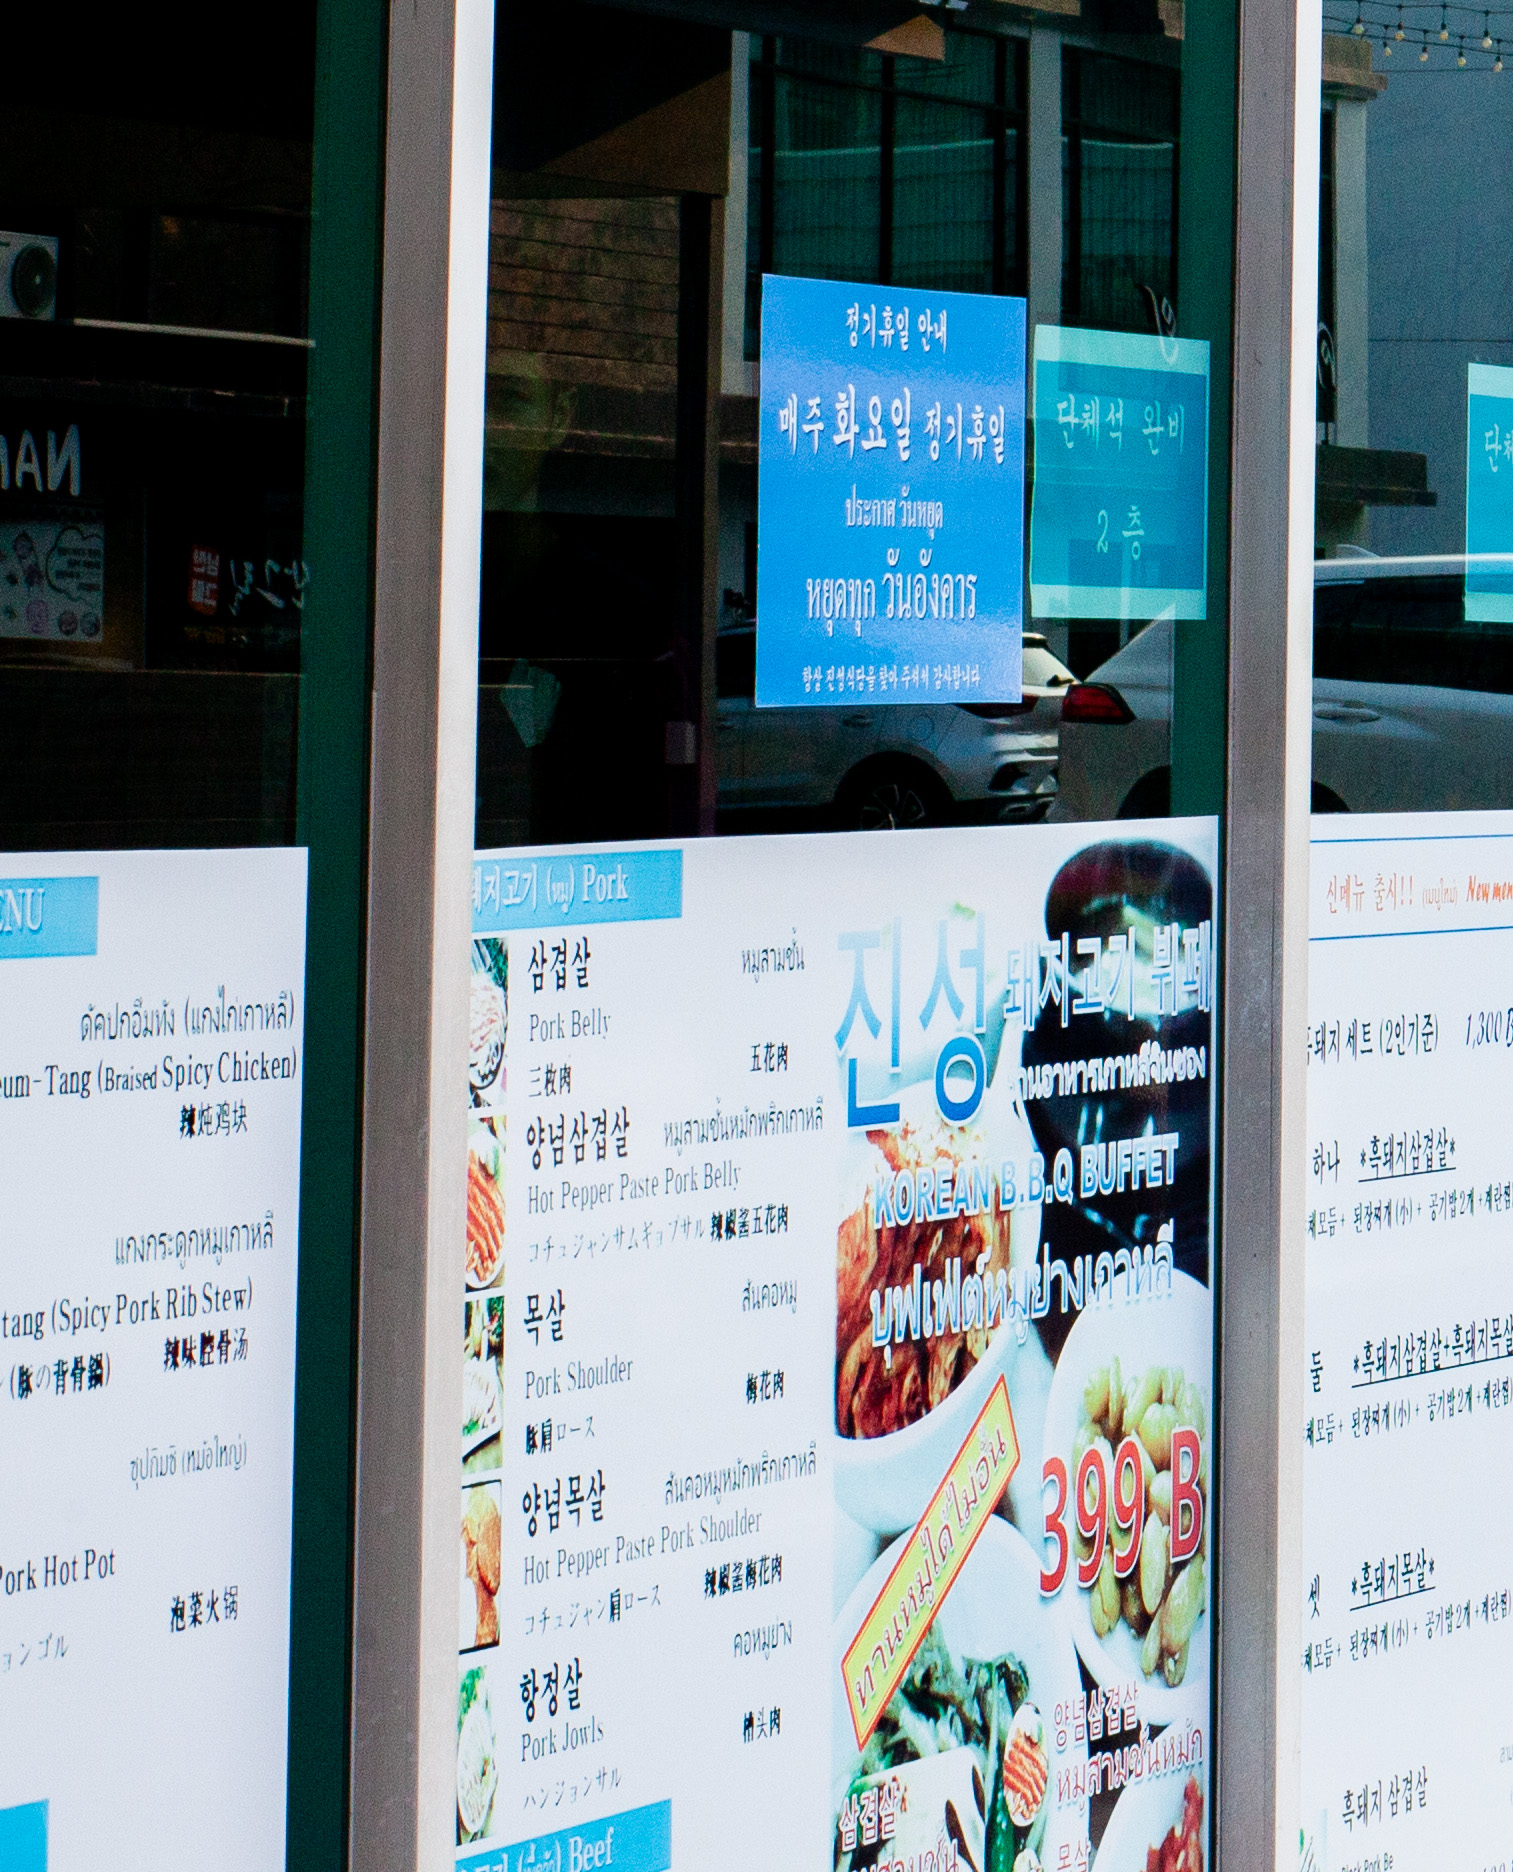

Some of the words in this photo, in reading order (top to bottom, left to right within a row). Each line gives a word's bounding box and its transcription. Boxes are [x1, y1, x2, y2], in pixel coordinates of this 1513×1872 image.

[845, 301, 910, 353] 정기휴일
[918, 308, 948, 354] 안내
[779, 393, 825, 456] 매주
[832, 384, 912, 461] 화요일
[924, 401, 1006, 464] 정기휴일
[1057, 393, 1125, 454] 단체석
[845, 483, 897, 529] ประกาศ
[898, 486, 944, 539] วันหยุด
[806, 576, 876, 637] หยุดทุก
[881, 547, 979, 620] วันอังคาร
[582, 864, 629, 905] Pork
[1466, 874, 1490, 904] New
[528, 936, 591, 994] 삼겹살
[741, 927, 805, 984] หมูสามชั้น
[1004, 926, 1136, 1031] 돼지고기
[529, 1011, 566, 1042] Pork
[571, 1007, 611, 1040] Belly
[834, 911, 987, 1131] 진성
[99, 1058, 158, 1093] (Braised
[163, 1054, 214, 1092] Spicy
[218, 1046, 298, 1083] Chicken)
[528, 1062, 572, 1099] 三枚肉
[750, 1041, 789, 1073] 五花肉
[526, 1105, 630, 1171] 양념삼겹살
[1312, 1140, 1341, 1185] 하나
[528, 1185, 555, 1215] Hot
[561, 1174, 615, 1211] Pepper
[619, 1171, 659, 1202] Paste
[665, 1166, 699, 1195] Pork
[703, 1159, 742, 1193] Belly
[873, 1164, 991, 1231] KOREAN
[1000, 1146, 1074, 1212] B.B.Q
[1080, 1131, 1180, 1199] BUFFET
[52, 1297, 111, 1335] (Spicy
[115, 1290, 161, 1326] Pork
[166, 1284, 197, 1319] Rib
[202, 1275, 254, 1314] Stew)
[523, 1288, 566, 1347] 목살
[526, 1368, 562, 1400] Pork
[567, 1354, 634, 1392] Shoulder
[522, 1469, 605, 1539] 양념목살
[1039, 1434, 1144, 1598] 399
[1170, 1426, 1204, 1564] B
[44, 1554, 79, 1589] Hot
[84, 1548, 116, 1579] Pot
[524, 1553, 551, 1586] Hot
[557, 1540, 610, 1579] Pepper
[615, 1534, 655, 1564] Paste
[661, 1524, 695, 1554] Pork
[700, 1510, 763, 1545] Shoulder
[519, 1656, 583, 1723] 항정살
[1054, 1680, 1140, 1754] 양념삼겹살
[521, 1723, 557, 1763] Pork
[562, 1714, 604, 1753] Jowls
[838, 1780, 900, 1854] 삼겹살
[1342, 1779, 1383, 1833] 흑돼지
[1388, 1765, 1428, 1818] 삼겹살
[568, 1826, 615, 1872] Beef
